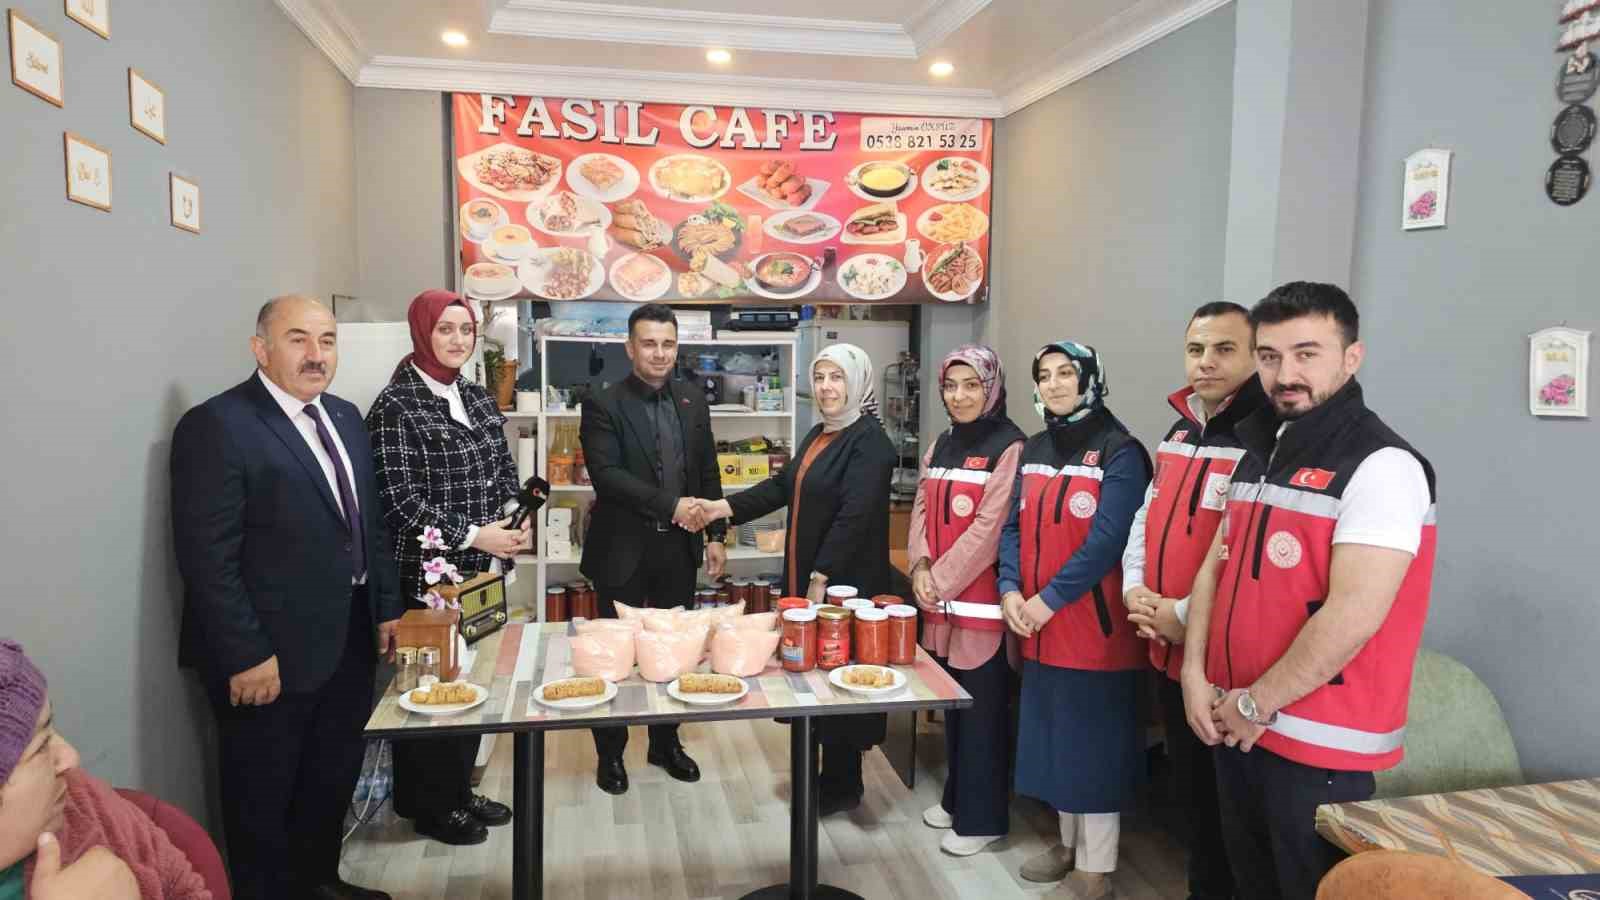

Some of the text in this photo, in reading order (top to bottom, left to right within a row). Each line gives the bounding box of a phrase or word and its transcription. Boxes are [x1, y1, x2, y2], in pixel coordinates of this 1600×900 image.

[478, 93, 838, 150] FASIL CAFE
[907, 135, 933, 148] 821
[939, 134, 956, 148] 53
[959, 134, 977, 148] 25
